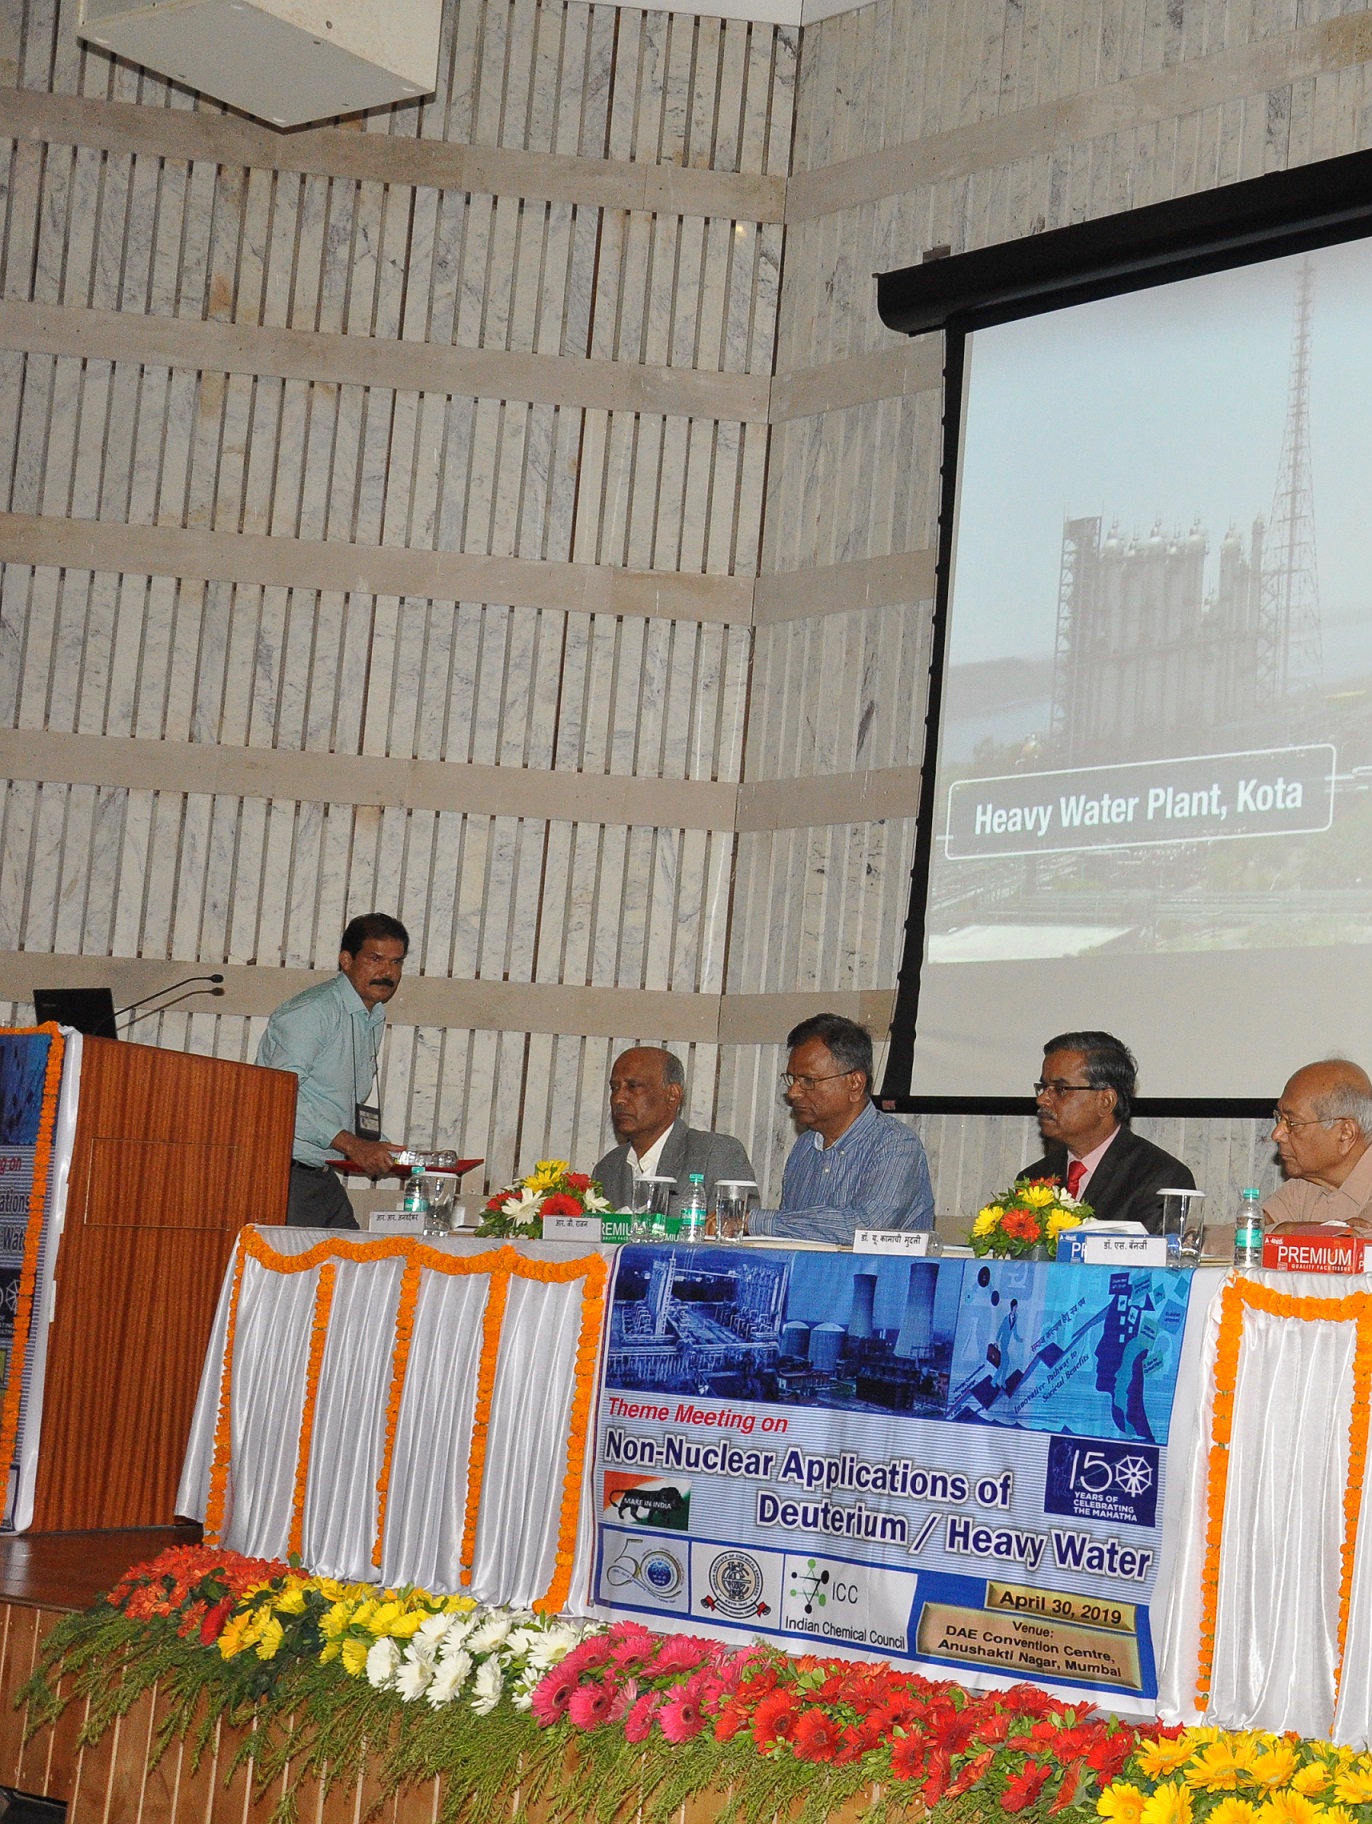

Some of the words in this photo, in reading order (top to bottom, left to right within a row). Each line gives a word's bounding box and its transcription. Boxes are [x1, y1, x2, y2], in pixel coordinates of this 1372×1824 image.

[974, 803, 1052, 836] Heavy
[1060, 793, 1139, 827] Water
[1147, 782, 1227, 820] Plant,
[1237, 777, 1302, 812] Kota
[0, 1190, 30, 1213] ations
[3, 1227, 26, 1251] Wat
[1103, 1238, 1112, 1251] डॉ.
[1114, 1240, 1127, 1251] एस.
[1278, 1245, 1352, 1267] PREMIUM
[1042, 1376, 1065, 1403] Societal
[1065, 1354, 1090, 1380] Benefits
[1046, 1357, 1070, 1384] Pathway
[1070, 1350, 1078, 1360] to
[609, 1397, 670, 1422] Theme
[674, 1404, 756, 1434] Meeting
[761, 1417, 789, 1433] on
[605, 1430, 775, 1478] Non-Nuclear
[780, 1449, 968, 1502] Applications
[976, 1472, 1012, 1507] of
[624, 1497, 643, 1506] MAKE
[653, 1502, 672, 1510] INDIA
[1073, 1499, 1134, 1514] CELEBRATING
[1074, 1491, 1104, 1502] YEARS
[1105, 1495, 1119, 1503] OF
[1073, 1506, 1091, 1516] THE
[1092, 1509, 1138, 1522] MAHATMA
[758, 1493, 907, 1543] Deuterium
[947, 1518, 1047, 1567] Heavy
[1052, 1530, 1152, 1580] Water
[832, 1582, 859, 1604] ICC
[999, 1590, 1046, 1611] April
[1052, 1599, 1076, 1618] 30,
[1081, 1604, 1122, 1625] 2019
[785, 1615, 820, 1633] Indian
[822, 1621, 867, 1642] Chemical
[869, 1630, 906, 1650] Council
[1012, 1620, 1054, 1638] Venue:
[937, 1638, 1014, 1661] Anushakti
[1018, 1652, 1061, 1670] Nagar,
[1065, 1659, 1122, 1678] Mumbai
[945, 1624, 978, 1640] DAE
[982, 1631, 1059, 1654] Convention
[1063, 1645, 1116, 1664] Centre,
